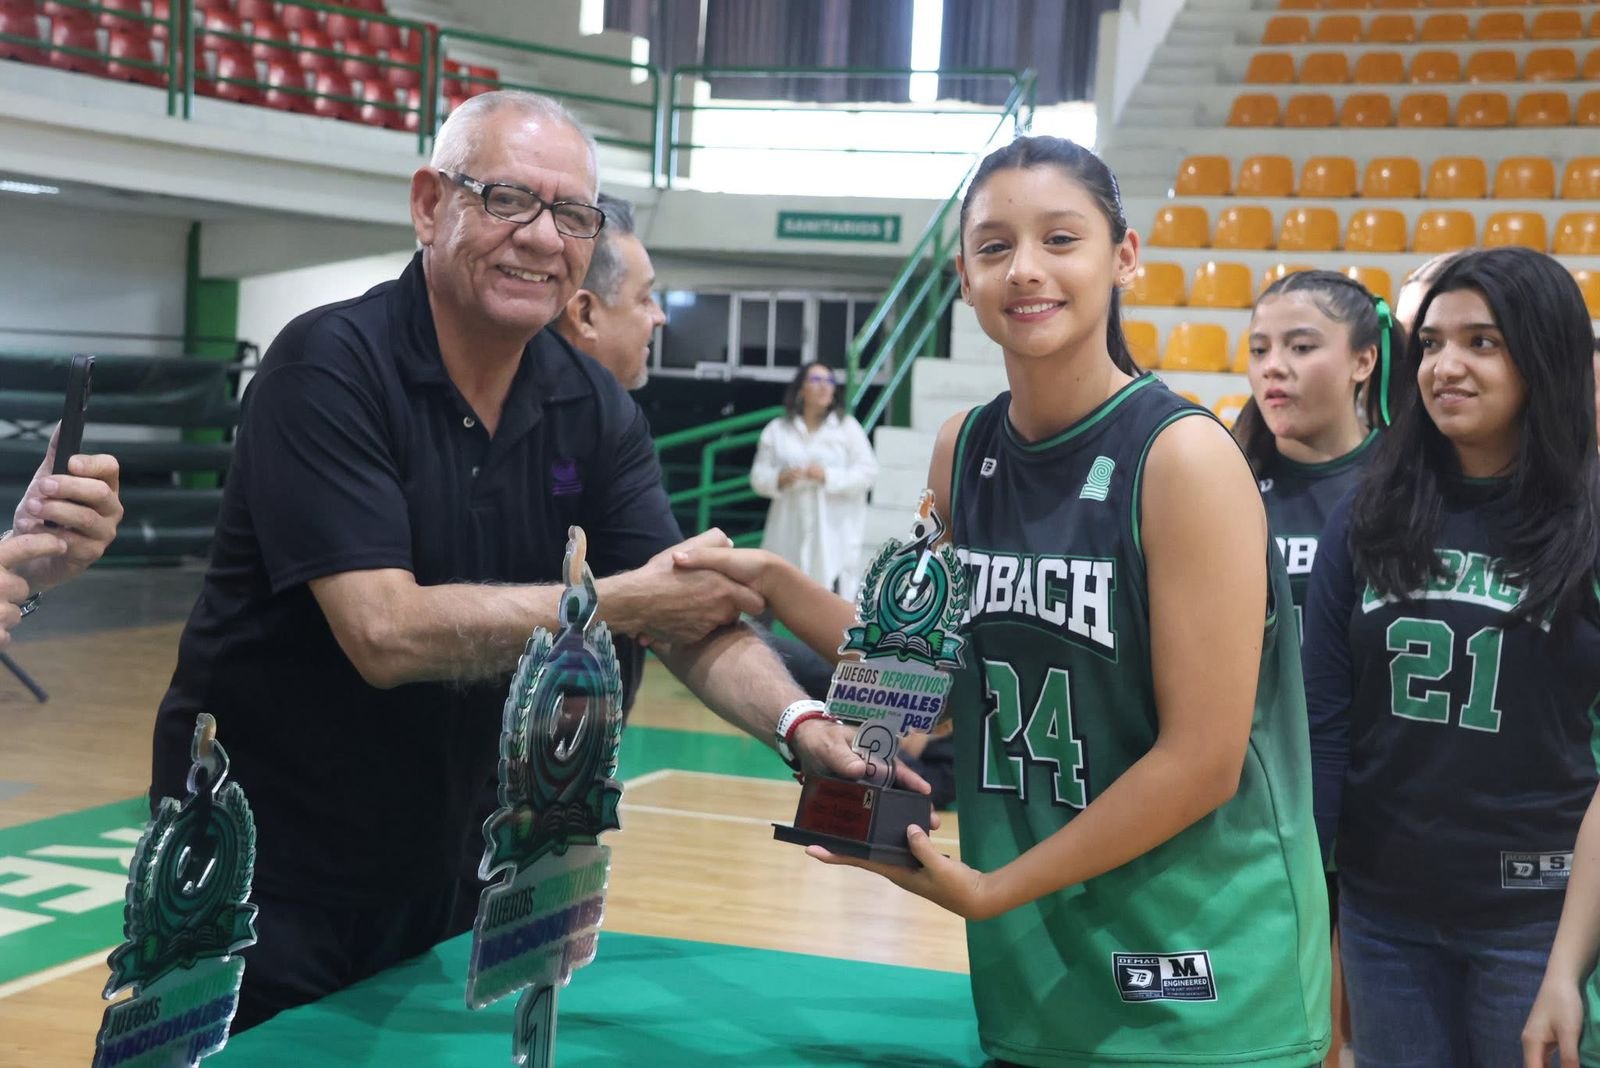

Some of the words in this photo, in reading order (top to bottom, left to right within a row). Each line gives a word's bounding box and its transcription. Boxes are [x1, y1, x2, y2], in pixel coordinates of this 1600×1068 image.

[838, 665, 879, 685] JUEGOS
[879, 670, 947, 694] DEPORTIVOS
[1386, 617, 1503, 733] 21
[833, 684, 941, 713] NACIONALES
[829, 702, 887, 719] COBACH
[900, 713, 932, 733] paz
[982, 657, 1087, 809] 24
[859, 725, 893, 788] 3
[1549, 856, 1565, 870] S
[1168, 957, 1200, 978] M
[1163, 979, 1207, 988] ENGINEERED
